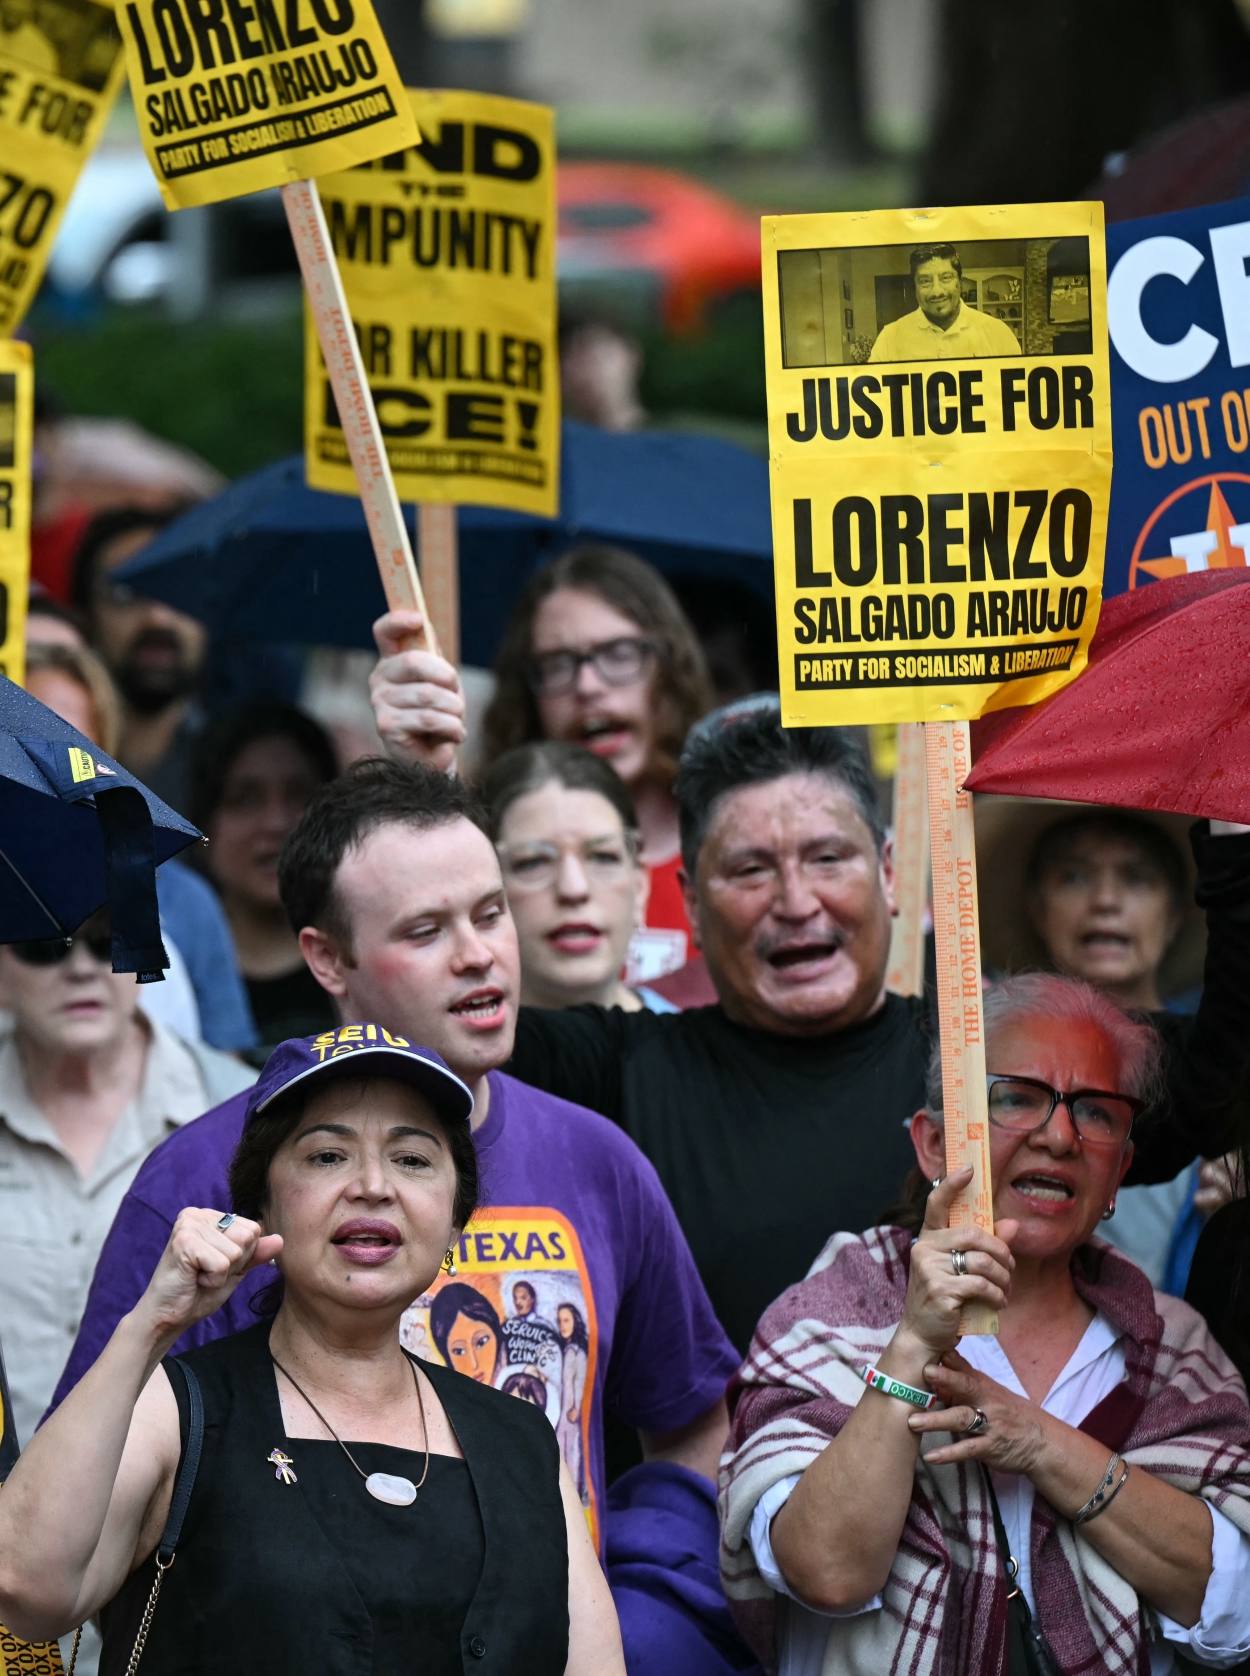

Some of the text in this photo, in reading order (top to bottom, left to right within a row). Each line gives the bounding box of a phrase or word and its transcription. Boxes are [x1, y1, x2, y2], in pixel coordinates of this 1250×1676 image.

[19, 82, 96, 147] FOR
[146, 38, 378, 137] SALGADO ARAUJO
[160, 92, 390, 171] PARTY FOR SOCIALISM & LIBERATION
[344, 121, 541, 183] ND
[397, 181, 469, 198] THE
[330, 199, 541, 281] MPUNITY
[410, 323, 543, 394] KILLER
[323, 378, 540, 451] ICE!
[786, 365, 1094, 442] JUSTICE FOR
[1138, 397, 1211, 470] OUT
[793, 487, 1092, 588] LORENZO
[793, 586, 1088, 645] SALGADO ARAUJO
[799, 644, 1074, 683] PARTY FOR SOCIALISM & LIBERATION
[952, 728, 980, 1047] THE HOME DEPOT HOME OF
[313, 1024, 410, 1048] SEIU
[459, 1232, 566, 1262] TEXAS
